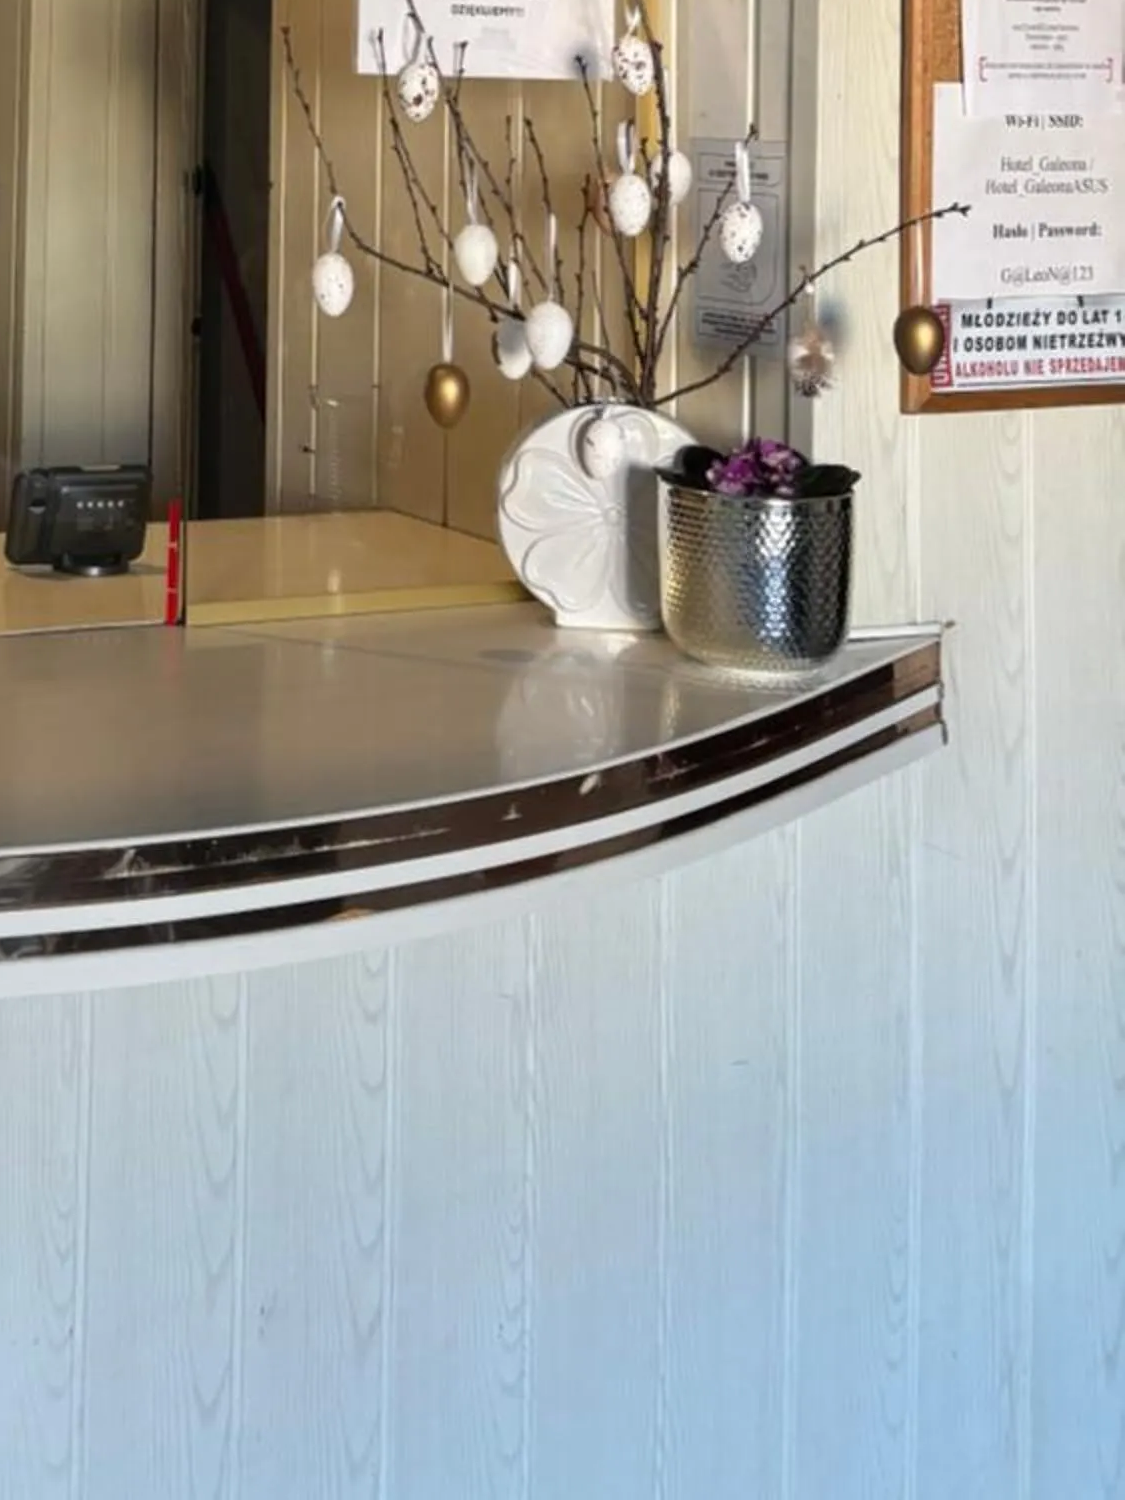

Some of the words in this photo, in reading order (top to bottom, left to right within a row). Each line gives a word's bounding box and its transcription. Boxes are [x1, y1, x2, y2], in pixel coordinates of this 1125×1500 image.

[961, 309, 1051, 328] MŁODZIEŻY
[1057, 309, 1077, 326] DO
[1082, 309, 1109, 325] LAT
[964, 335, 1027, 353] OSOBOM
[1033, 329, 1125, 351] NIETRZEŹWY
[955, 360, 1019, 377] ALKOHOLU
[1024, 358, 1044, 376] NIE
[1050, 355, 1125, 374] SPRZEDAJEM
